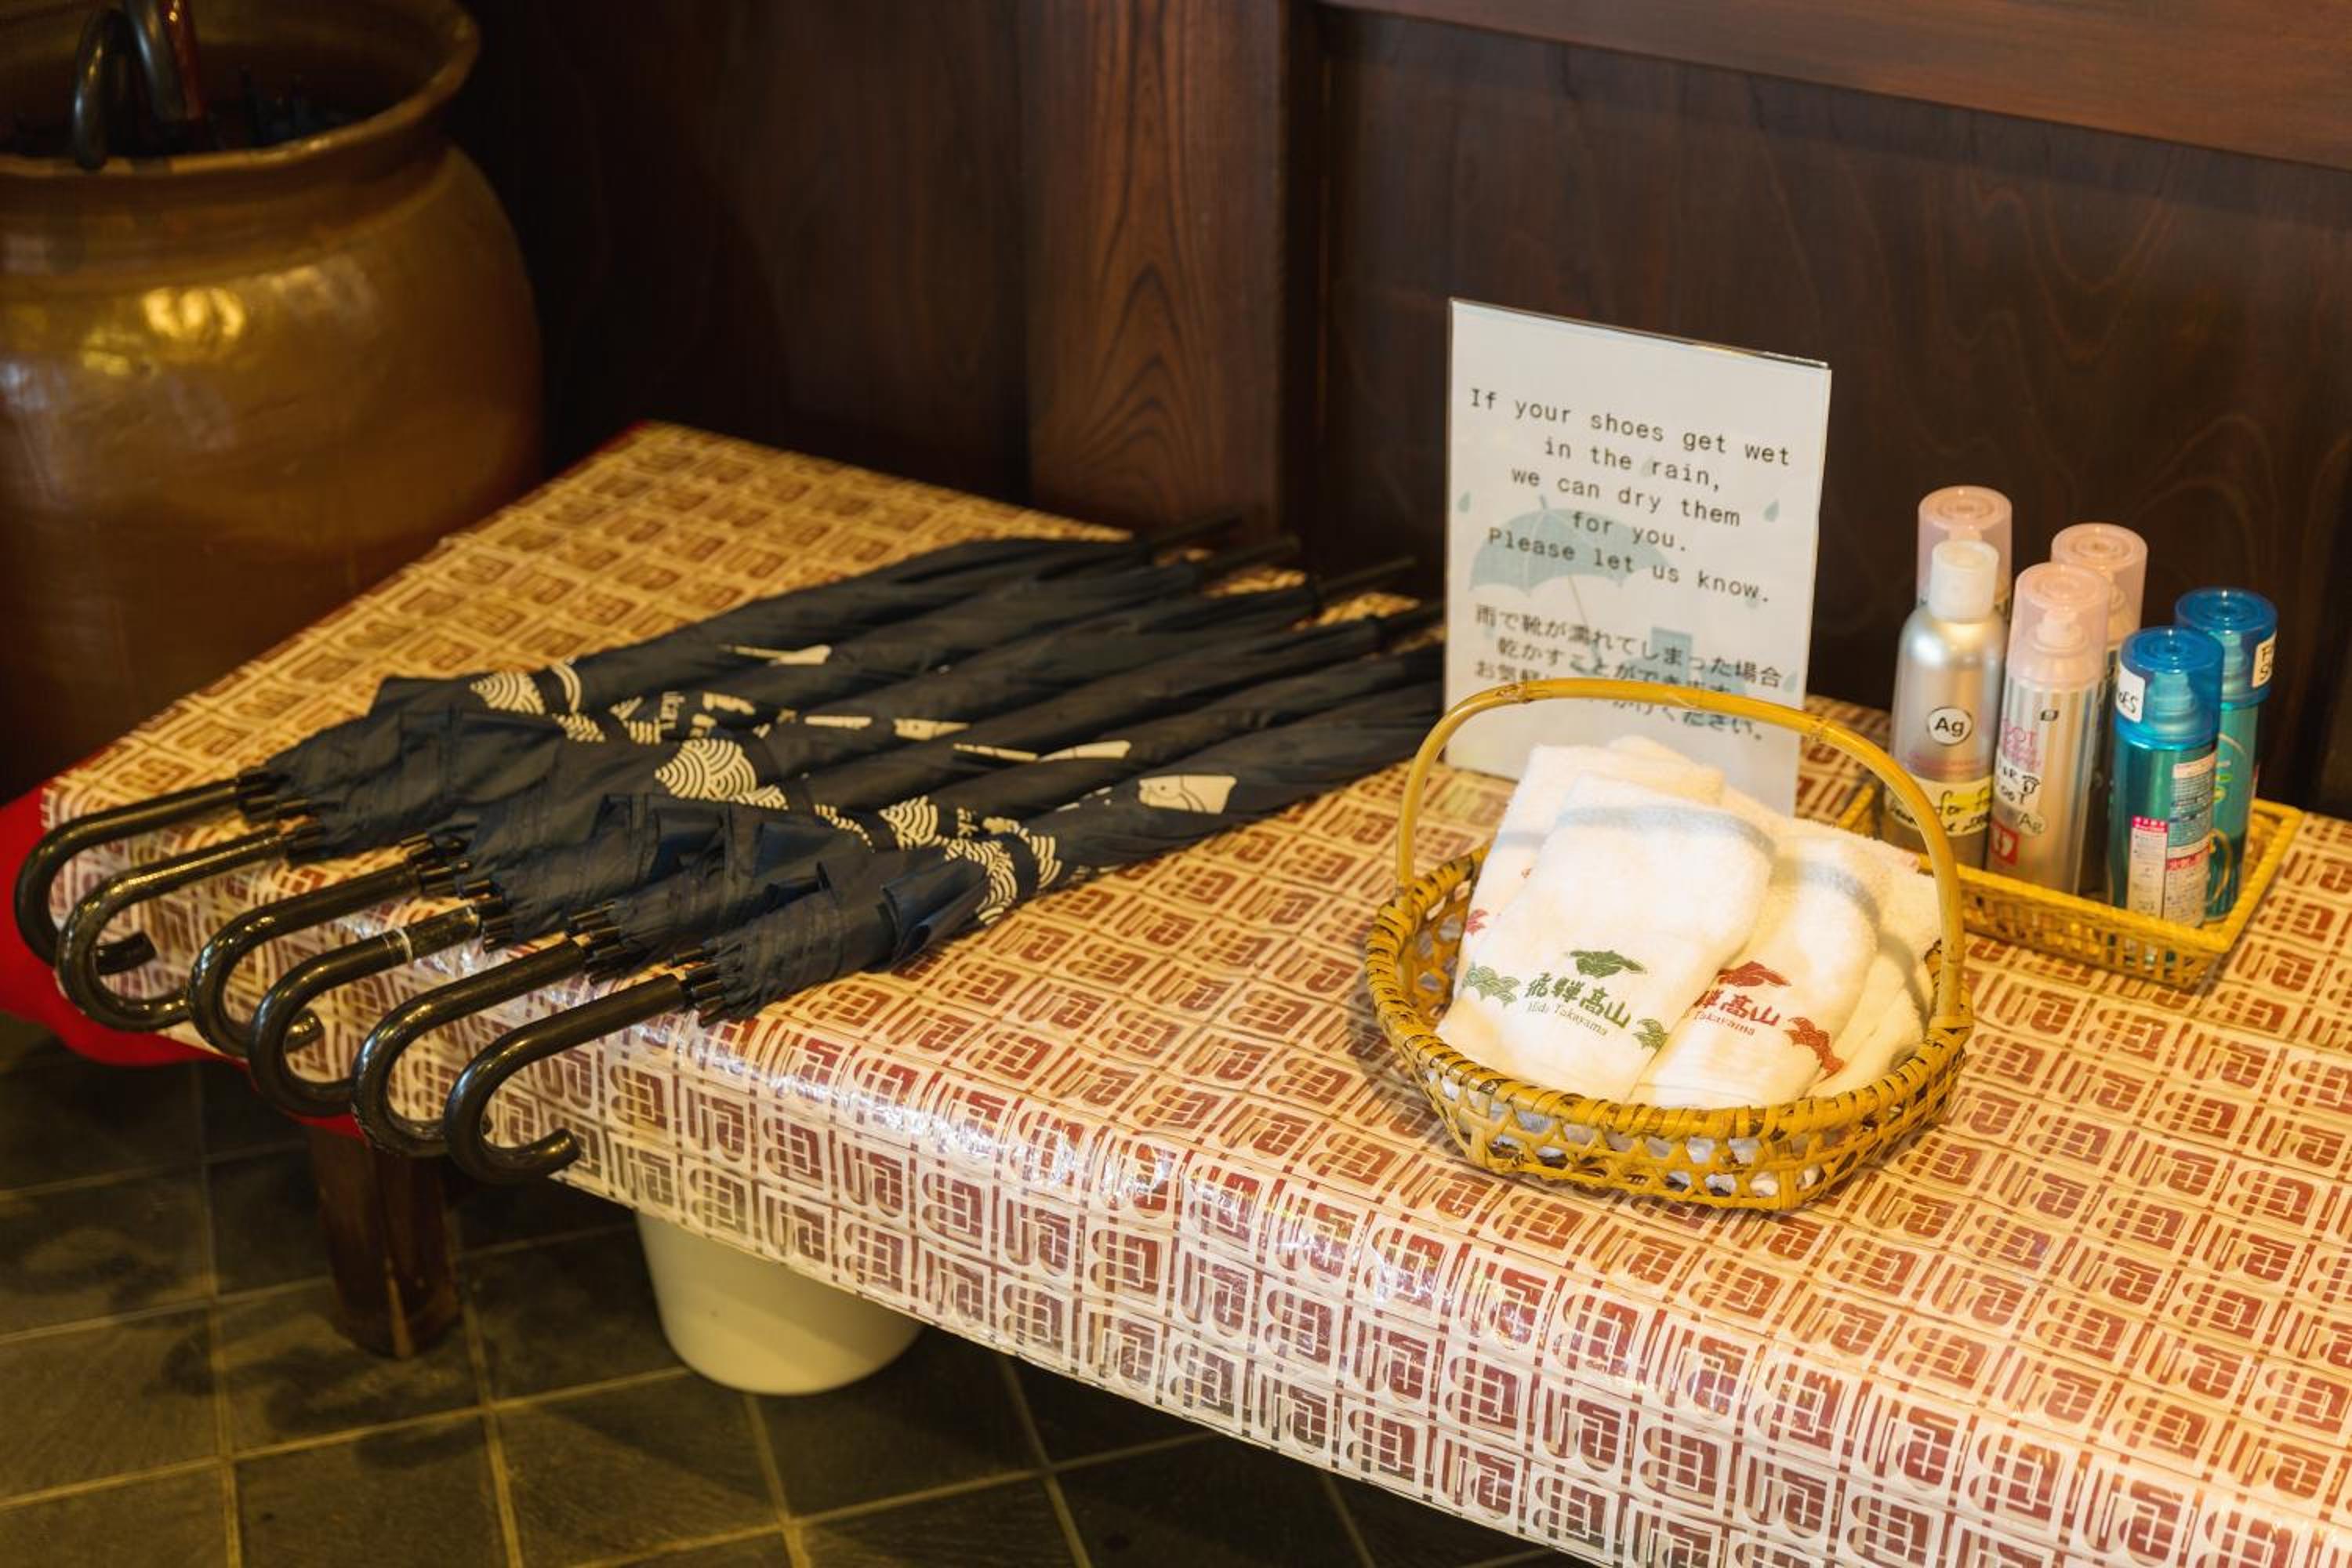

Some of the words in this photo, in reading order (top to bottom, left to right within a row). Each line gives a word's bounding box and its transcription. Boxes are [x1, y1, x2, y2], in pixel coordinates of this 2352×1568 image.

[1471, 388, 1497, 409] If
[1515, 400, 1572, 424] your
[1590, 412, 1664, 442] shoes
[1682, 432, 1726, 454] get
[1744, 443, 1790, 466] wet
[1544, 436, 1571, 459] in
[1590, 445, 1632, 471] the
[1651, 460, 1719, 492] rain,
[1511, 468, 1541, 488] we
[1557, 477, 1600, 499] can
[1617, 486, 1661, 514] dry
[1681, 498, 1740, 527] them
[1572, 510, 1612, 535] for
[1632, 528, 1686, 552] you.
[1488, 527, 1576, 561] Please
[1594, 550, 1634, 573] let
[1652, 564, 1679, 584] us
[1697, 570, 1769, 603] know.
[1475, 604, 1782, 688] 雨で靴が濡れてしまった場合
[1934, 717, 1965, 738] Ag
